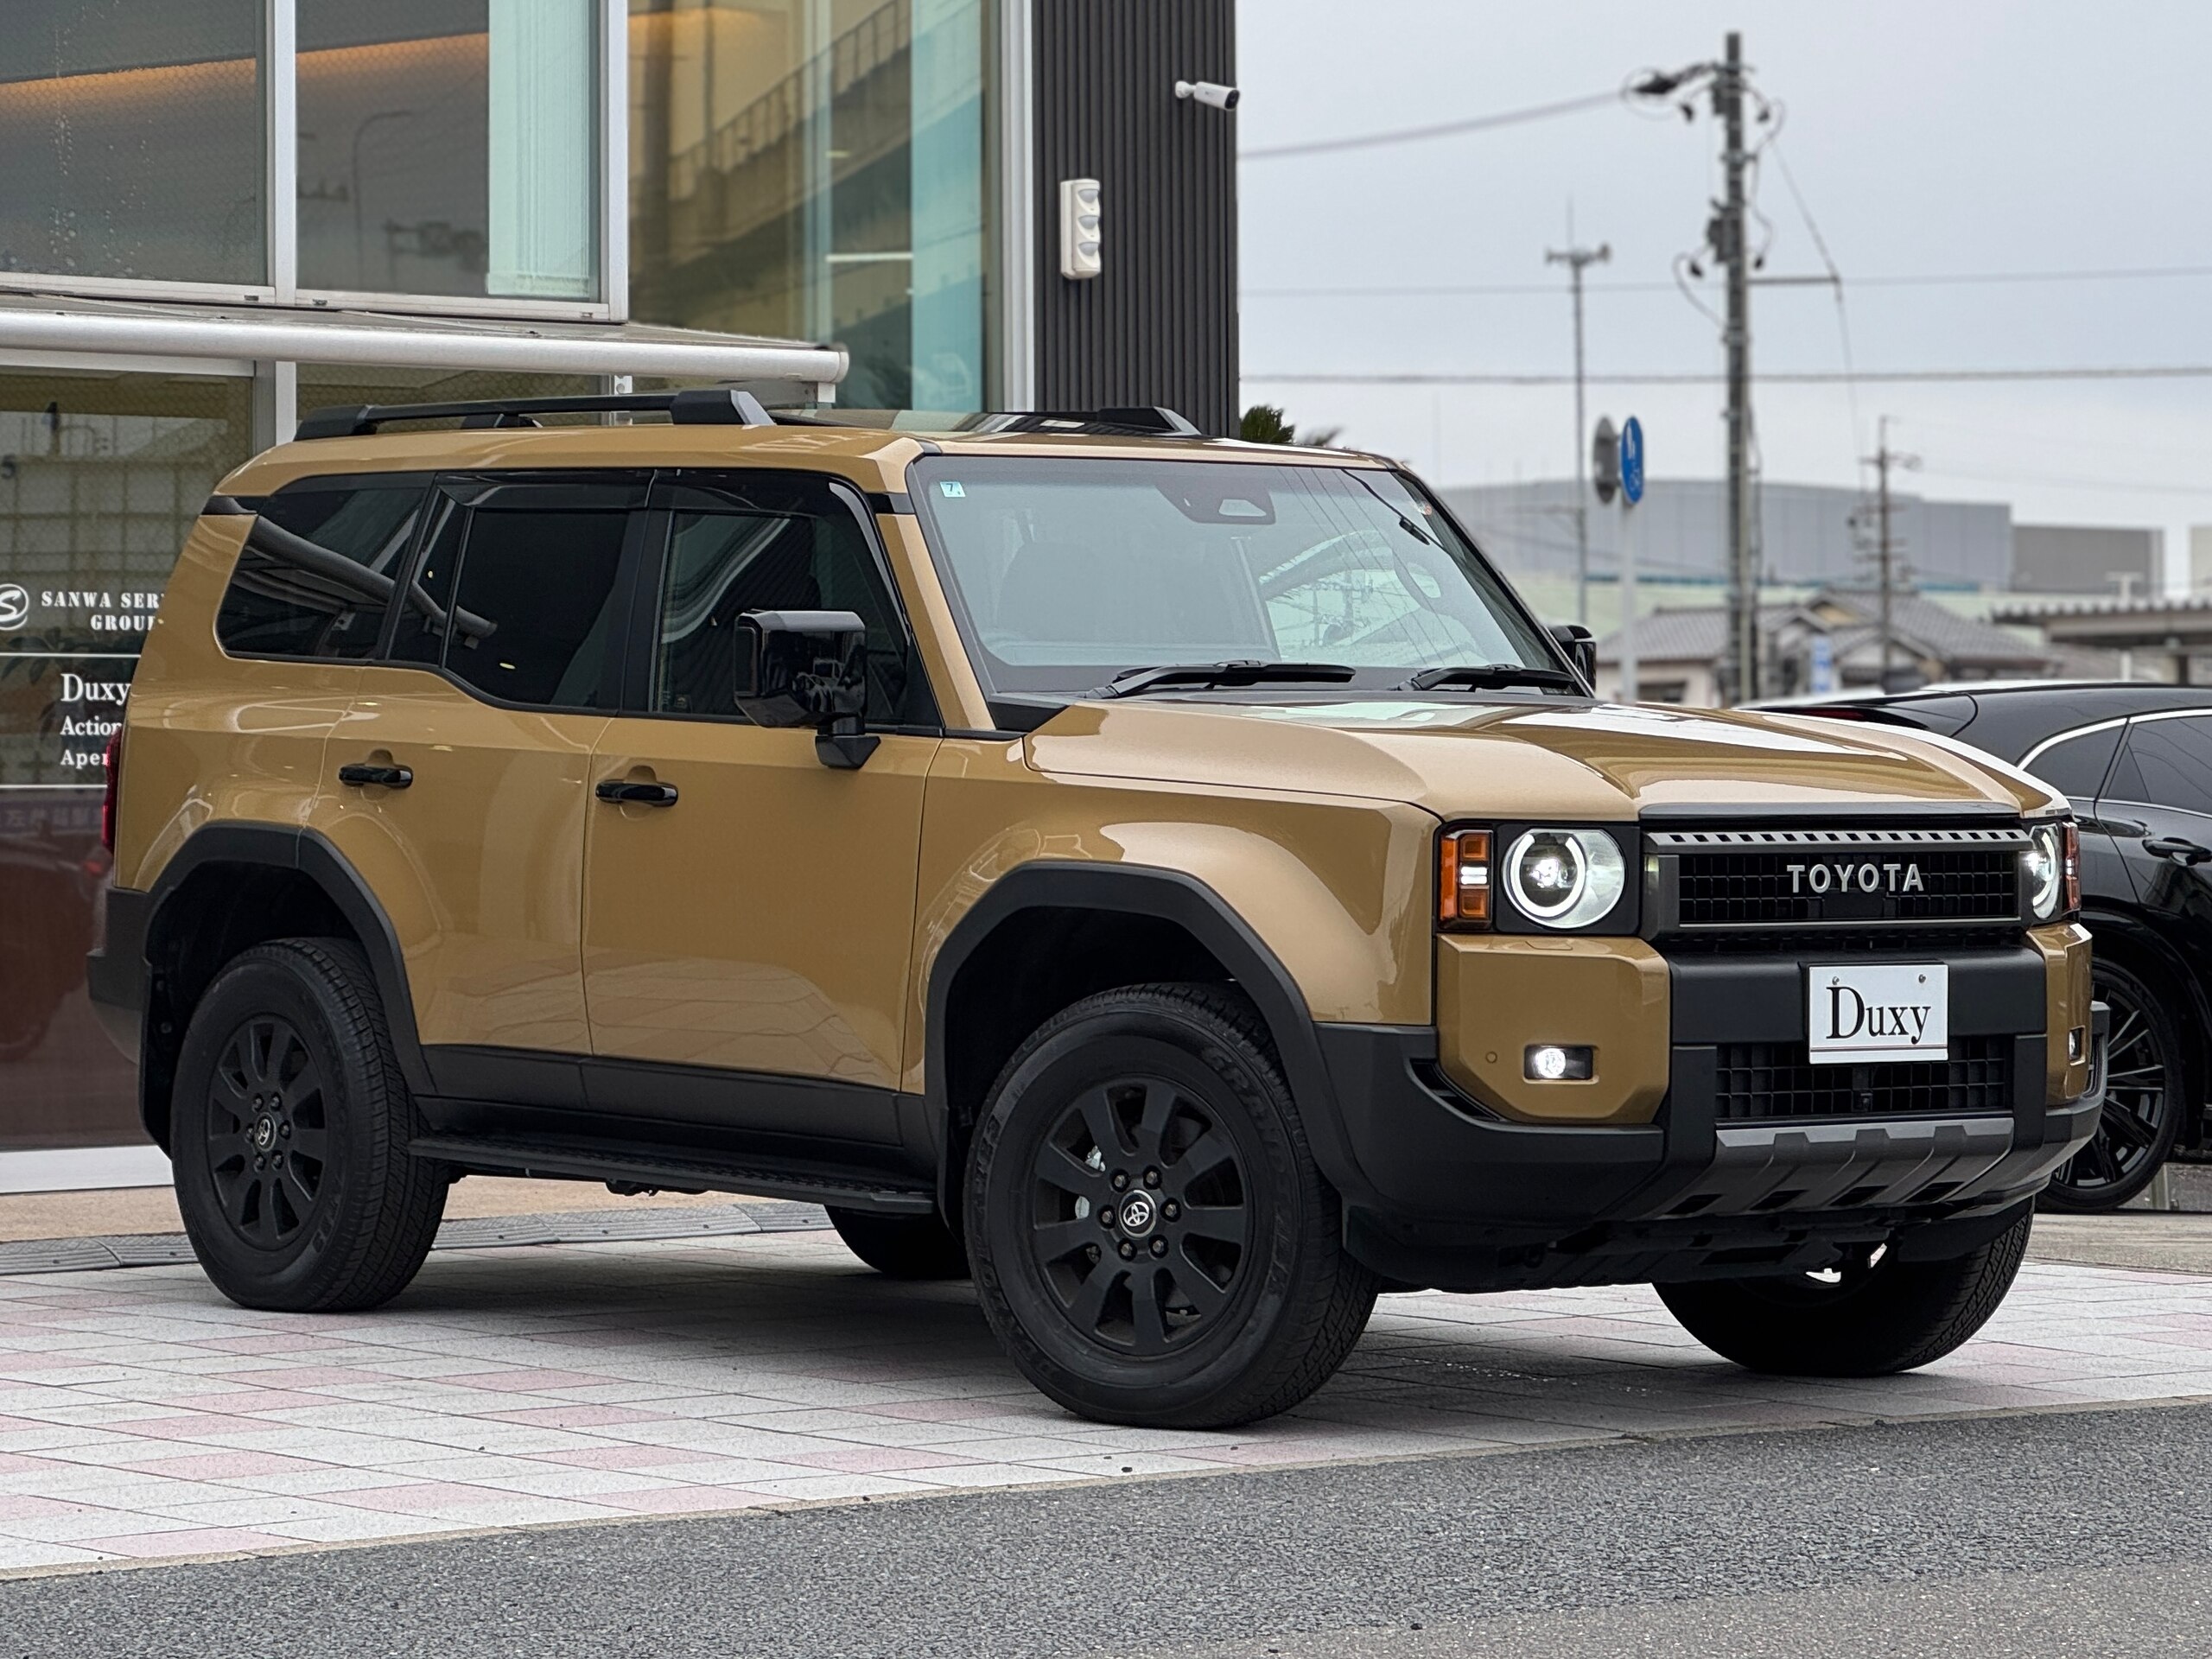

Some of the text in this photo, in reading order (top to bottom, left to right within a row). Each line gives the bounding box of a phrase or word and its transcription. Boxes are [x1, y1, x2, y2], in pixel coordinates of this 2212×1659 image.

[41, 590, 165, 609] SANWA SER
[60, 672, 132, 707] Duxy
[1786, 862, 1925, 894] TOYOTA
[1825, 985, 1932, 1046] Duxy
